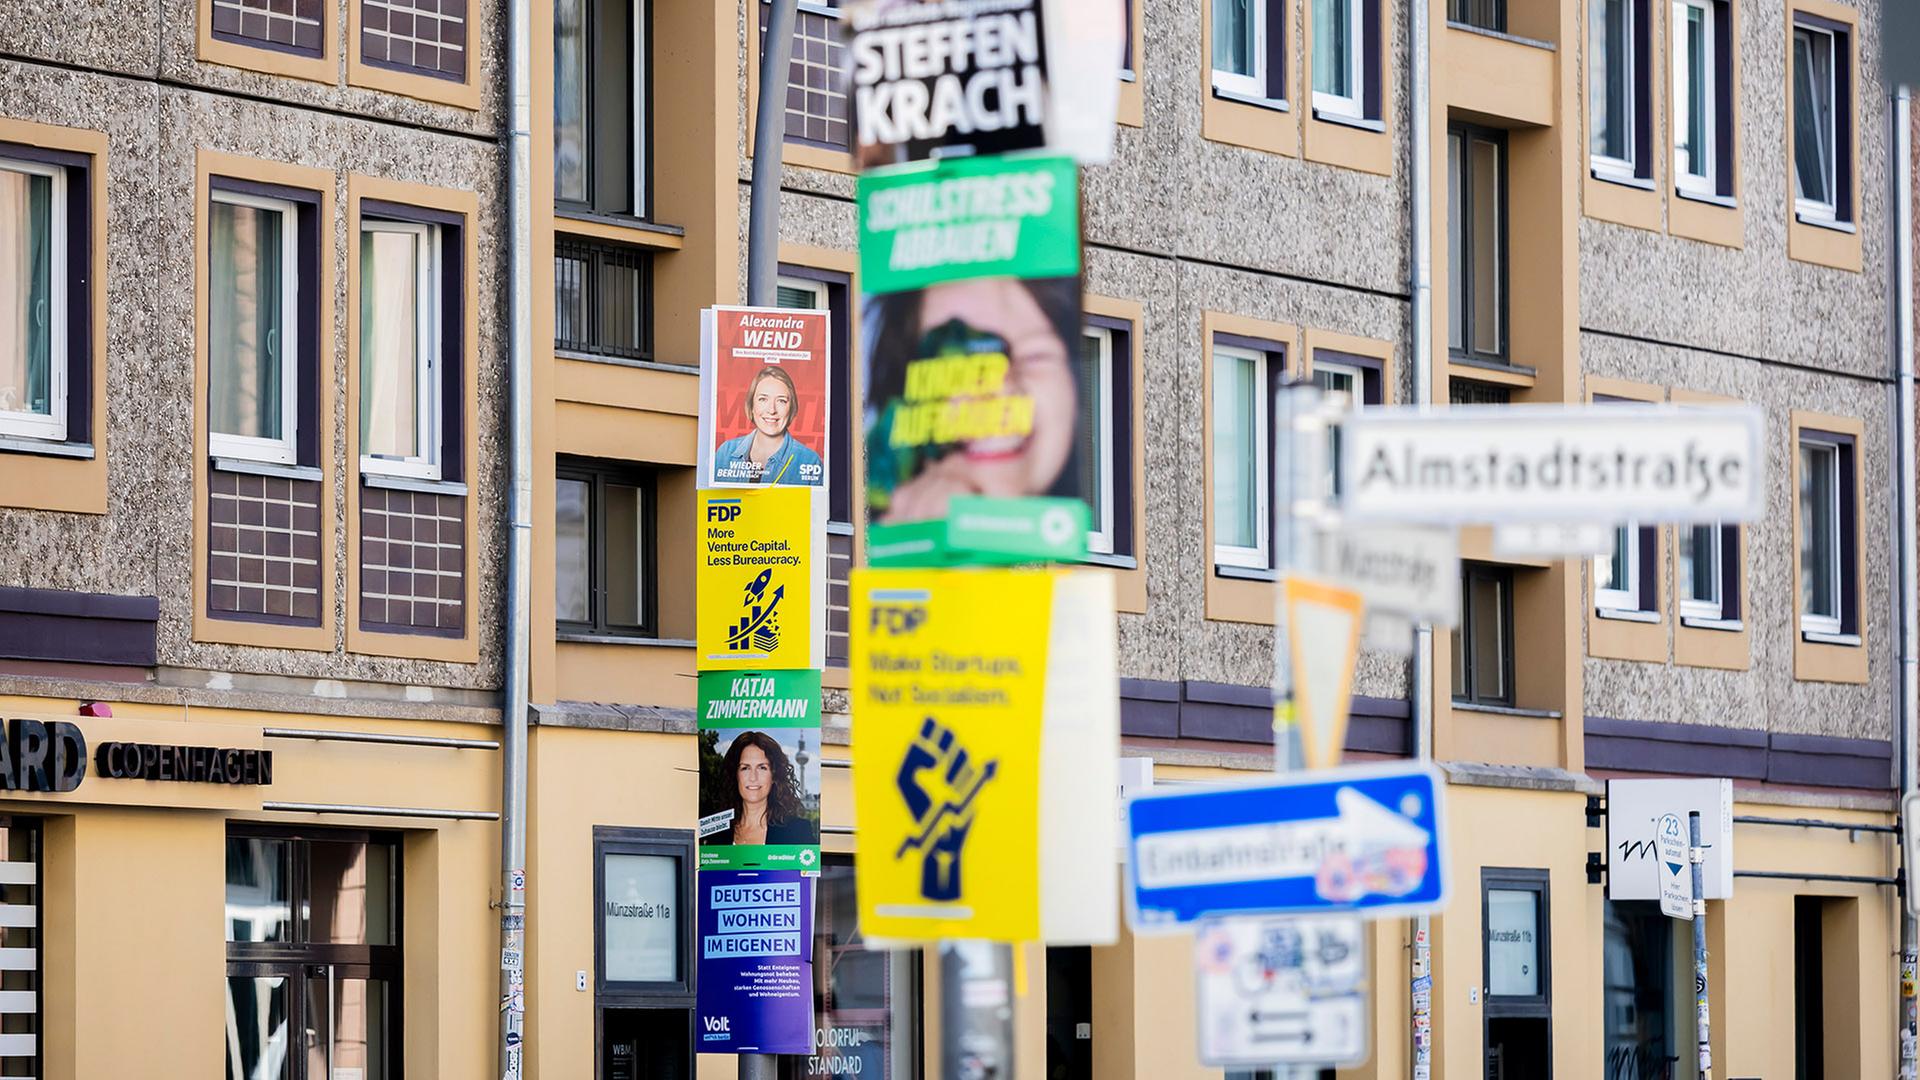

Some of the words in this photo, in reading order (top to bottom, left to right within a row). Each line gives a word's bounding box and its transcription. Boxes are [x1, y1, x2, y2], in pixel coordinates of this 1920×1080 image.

[854, 10, 1039, 85] STEFFEN
[856, 65, 1043, 146] KRACH
[740, 315, 804, 330] Alexandra
[744, 330, 802, 349] WEND
[717, 469, 747, 478] BERLIN
[729, 461, 762, 470] WIEDER
[799, 464, 822, 475] SPD
[1360, 445, 1745, 502] Almstadtstraße
[707, 506, 741, 522] FDP
[707, 528, 735, 538] More
[707, 541, 748, 552] Venture
[750, 540, 791, 552] Capital.
[707, 555, 731, 566] Less
[733, 554, 801, 566] Bureaucracy.
[870, 606, 928, 634] FDP
[730, 678, 775, 697] KATJA
[706, 699, 808, 719] ZIMMERMANN
[95, 742, 272, 785] COPENHAGEN
[1665, 818, 1679, 836] 23
[715, 889, 795, 902] DEUTSCHE
[607, 902, 653, 918] Münzstraße
[656, 904, 670, 918] 11a
[723, 914, 795, 927] WOHNEN
[708, 940, 722, 952] IM
[726, 939, 795, 952] EIGENEN
[703, 1016, 730, 1031] Volt
[815, 1028, 862, 1047] OLORFUL
[808, 1055, 862, 1075] STANDARD
